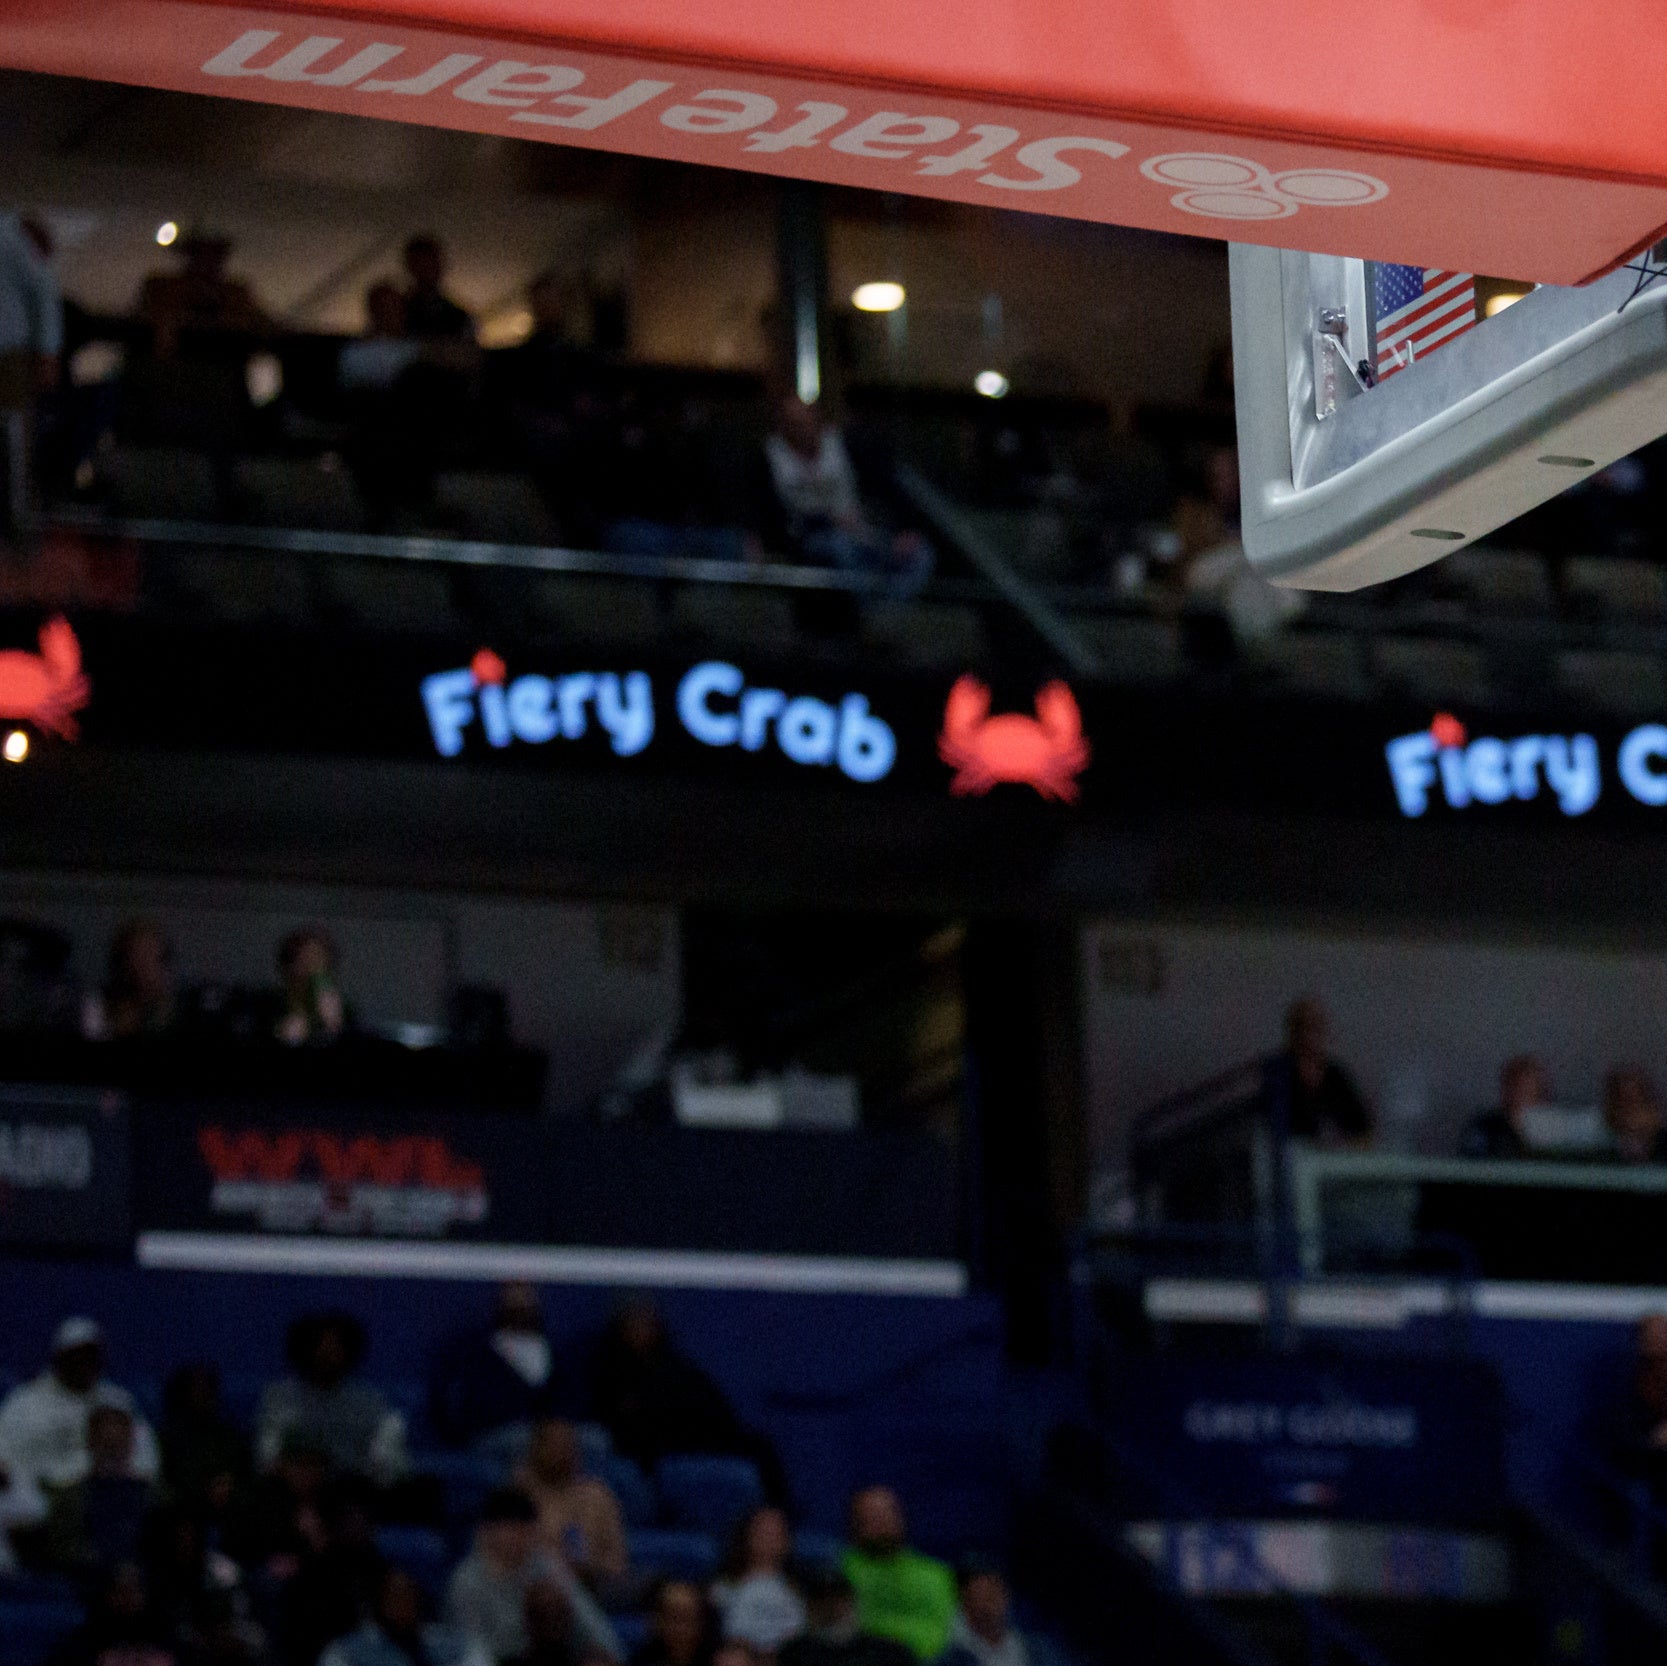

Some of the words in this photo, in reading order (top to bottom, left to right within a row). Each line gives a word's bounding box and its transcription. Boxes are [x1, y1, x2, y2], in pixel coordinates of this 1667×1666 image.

[421, 652, 654, 757] Fiery
[676, 661, 896, 782] Crab
[1385, 716, 1601, 817] Fiery
